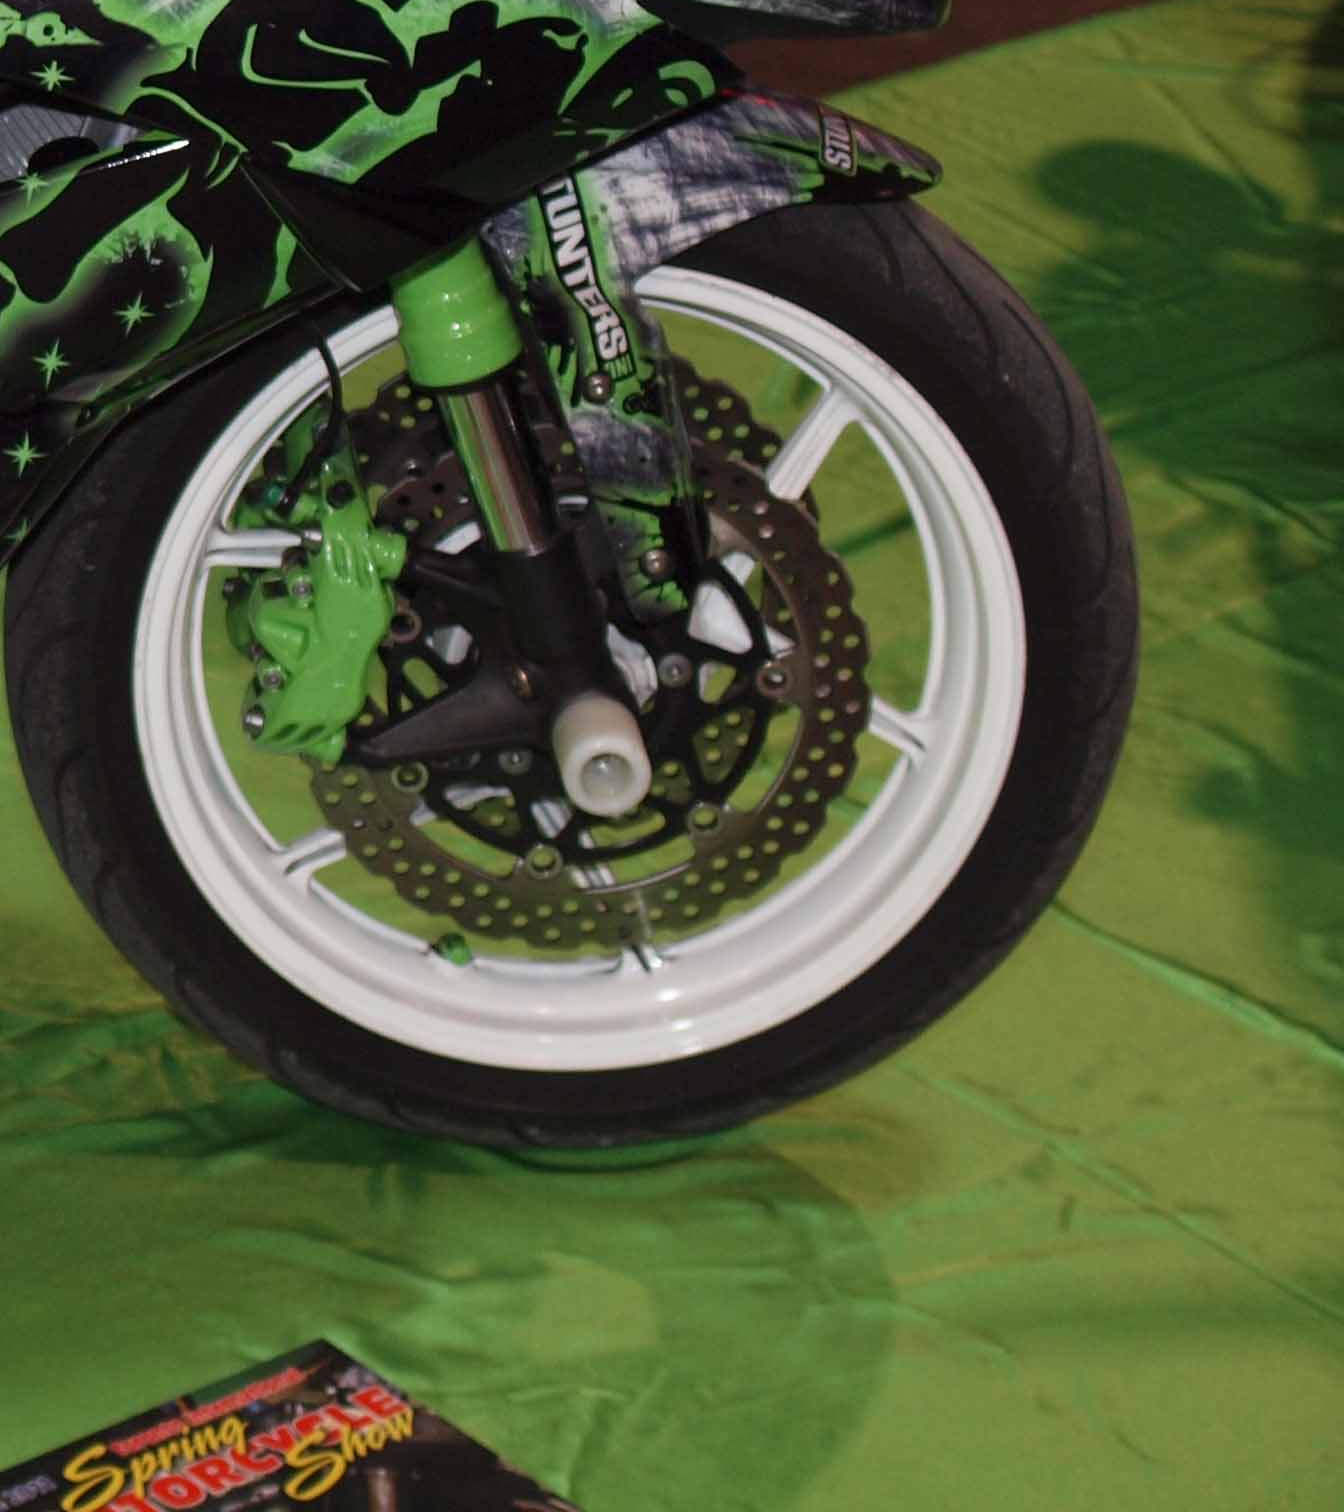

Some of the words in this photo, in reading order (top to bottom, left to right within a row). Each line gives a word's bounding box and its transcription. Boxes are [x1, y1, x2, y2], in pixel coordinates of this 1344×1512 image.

[539, 176, 630, 360] TUNTERS
[61, 1415, 249, 1512] Spring
[284, 1406, 414, 1502] Show
